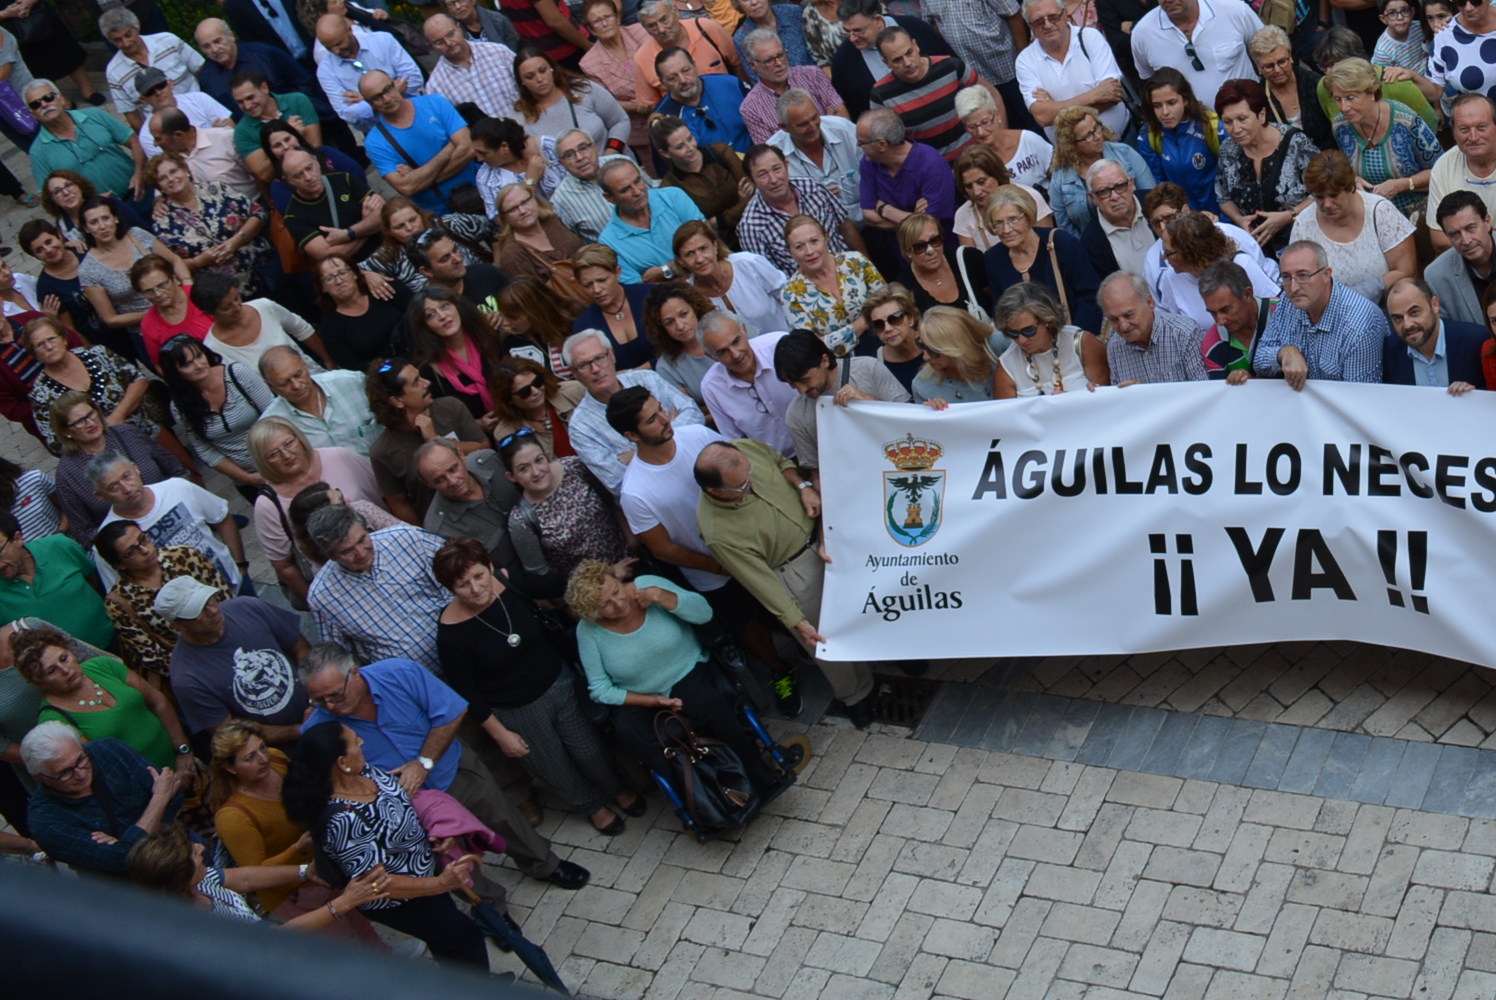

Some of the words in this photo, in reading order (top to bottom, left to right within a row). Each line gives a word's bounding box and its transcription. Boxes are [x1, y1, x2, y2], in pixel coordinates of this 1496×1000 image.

[972, 438, 1213, 500] ÁGUILAS
[1234, 442, 1303, 496] LO
[865, 551, 960, 573] Ayuntamiento
[900, 571, 918, 587] de
[1223, 525, 1359, 603] YA
[1376, 529, 1429, 616] !!
[861, 584, 963, 622] Águilas
